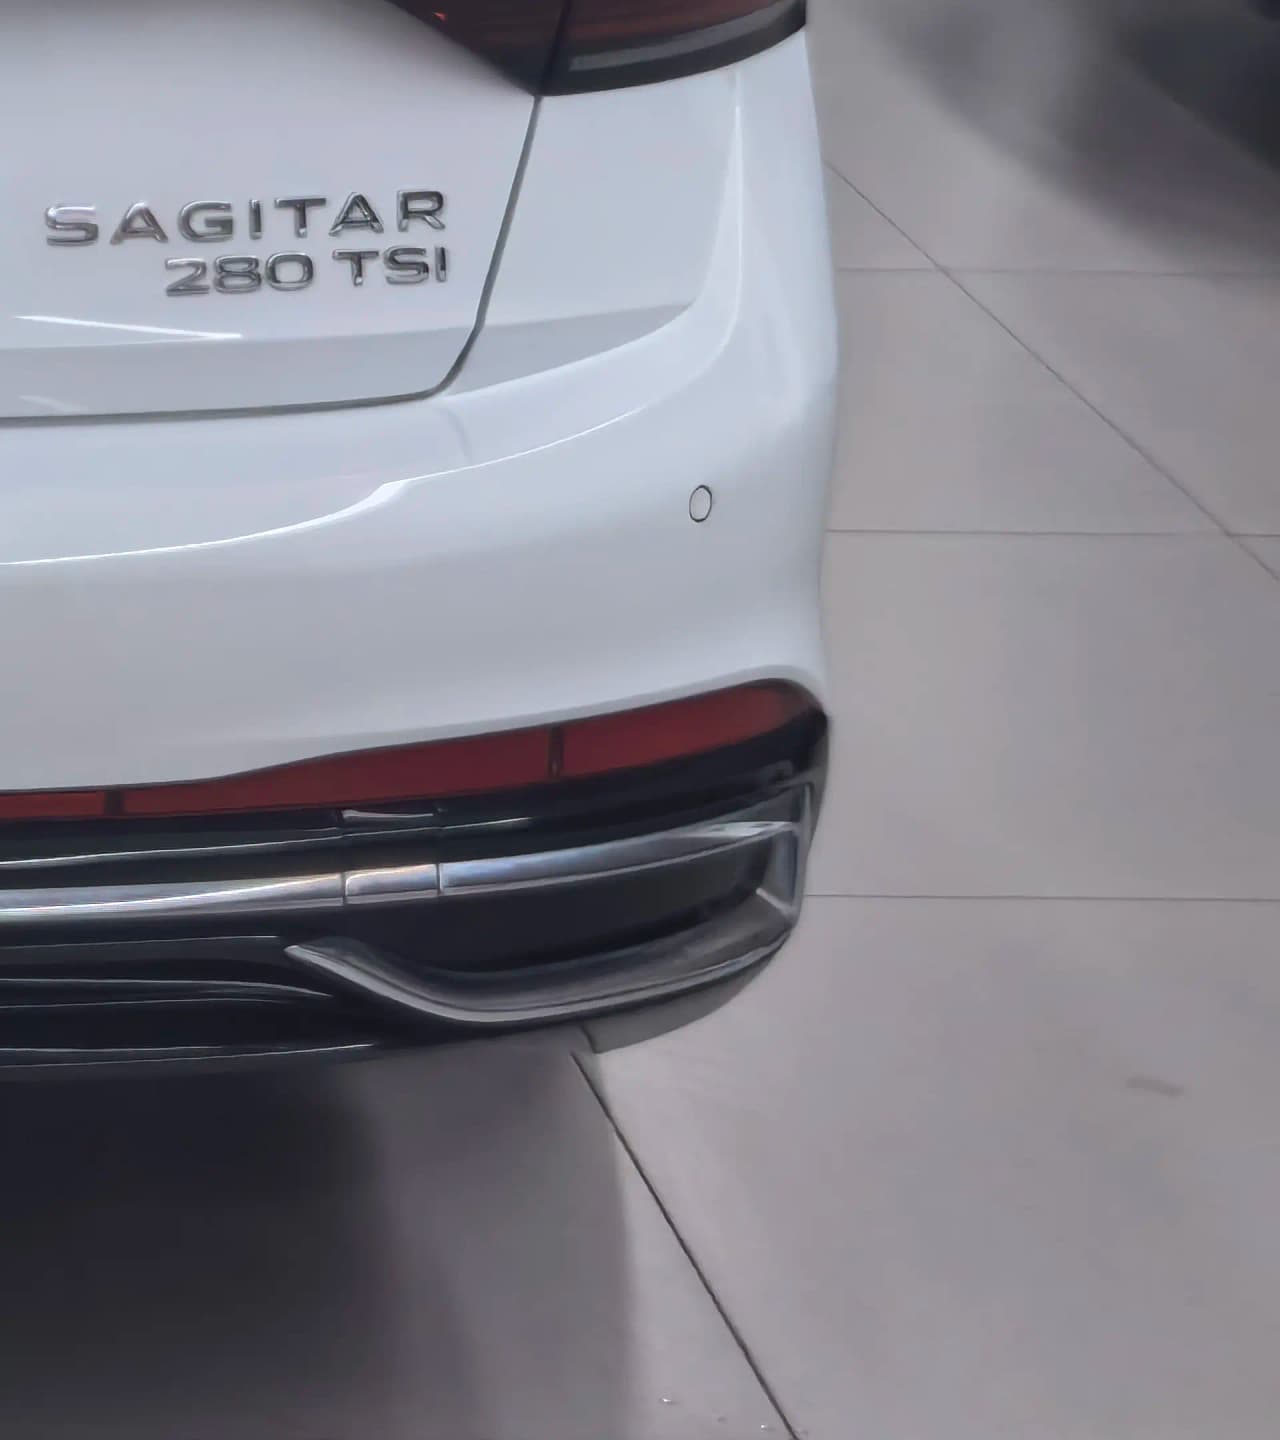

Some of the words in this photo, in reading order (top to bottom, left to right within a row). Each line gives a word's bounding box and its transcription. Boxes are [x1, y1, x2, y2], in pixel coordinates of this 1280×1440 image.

[44, 189, 448, 246] SAGITAR
[164, 250, 315, 297] 280
[331, 245, 448, 286] TSI
